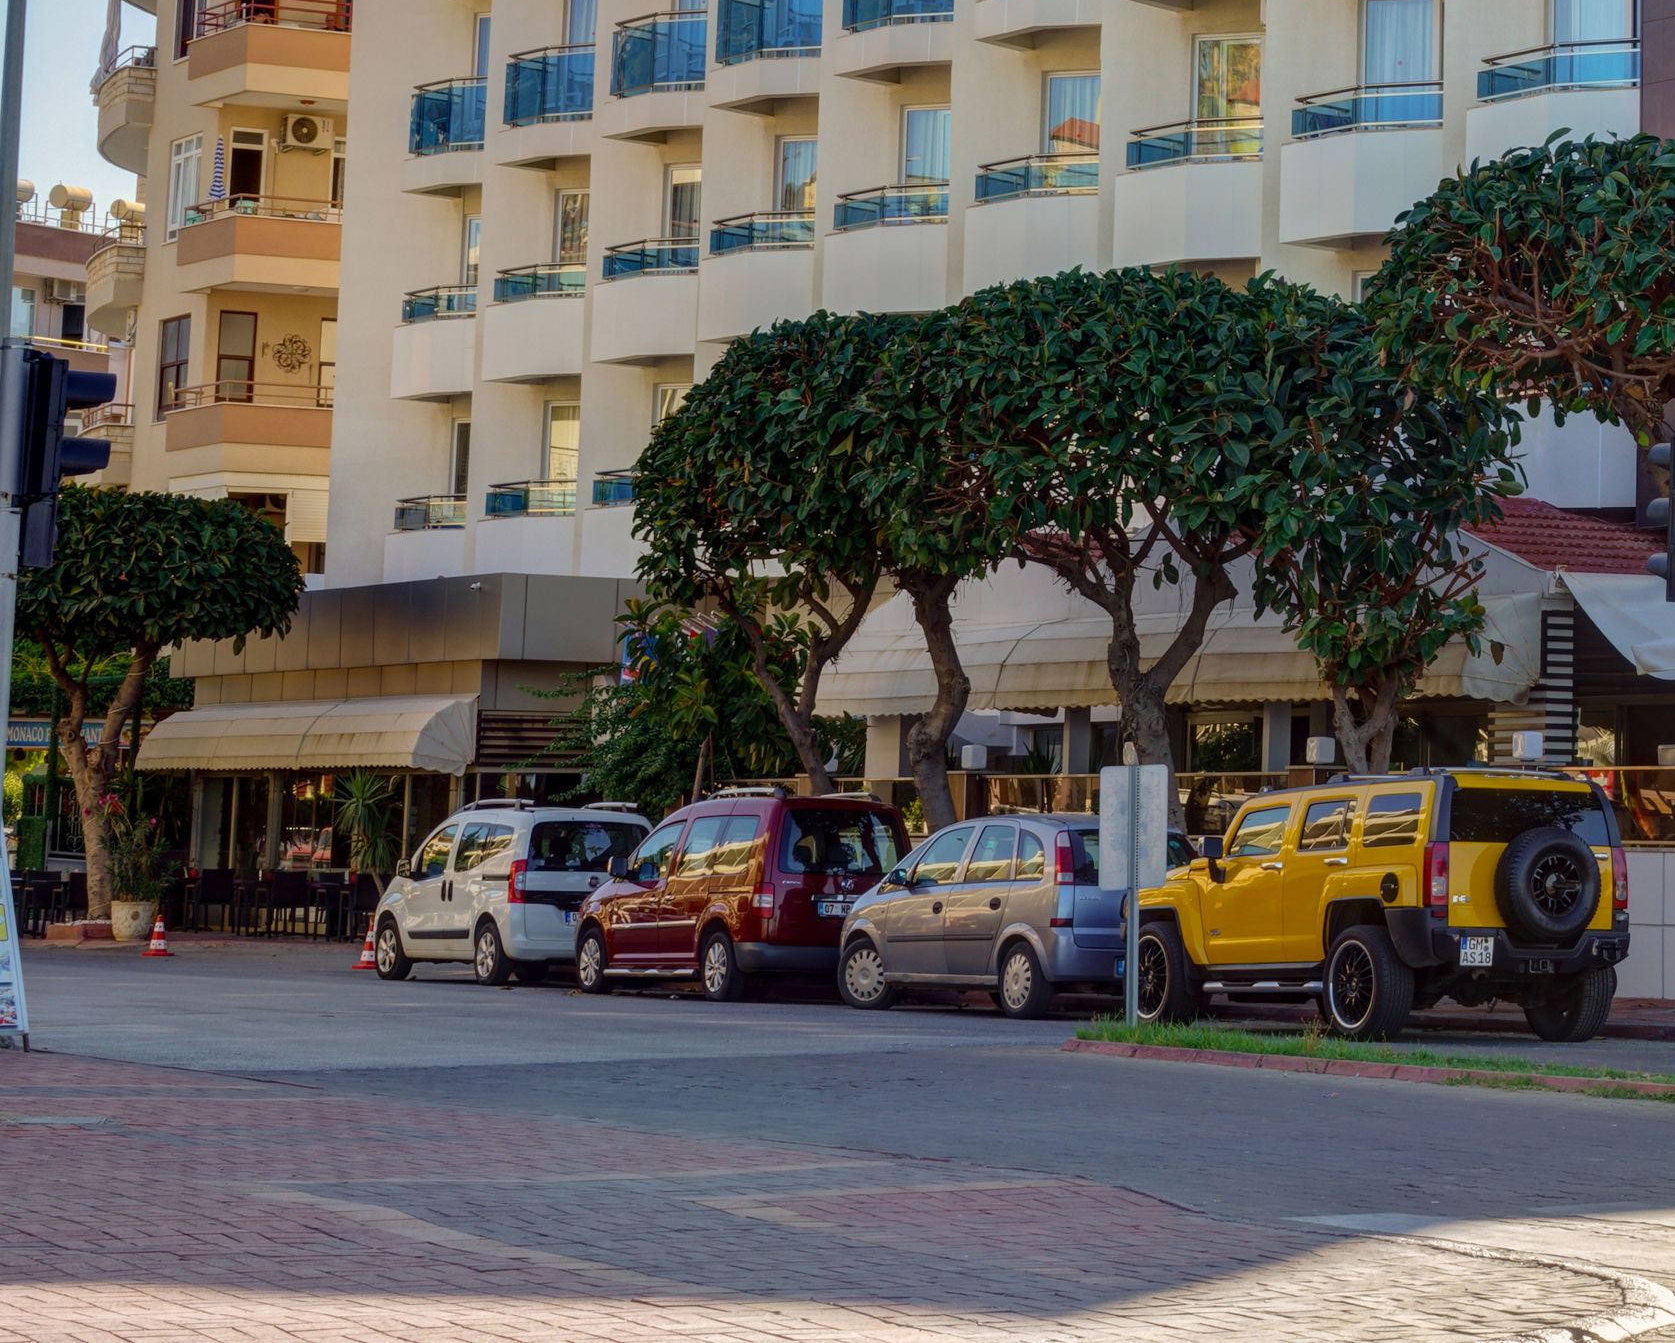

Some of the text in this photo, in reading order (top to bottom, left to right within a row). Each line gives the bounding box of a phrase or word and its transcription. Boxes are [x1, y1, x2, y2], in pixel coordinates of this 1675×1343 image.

[7, 726, 44, 742] MONACO
[1468, 938, 1483, 951] GM
[1462, 952, 1491, 964] AS 18
